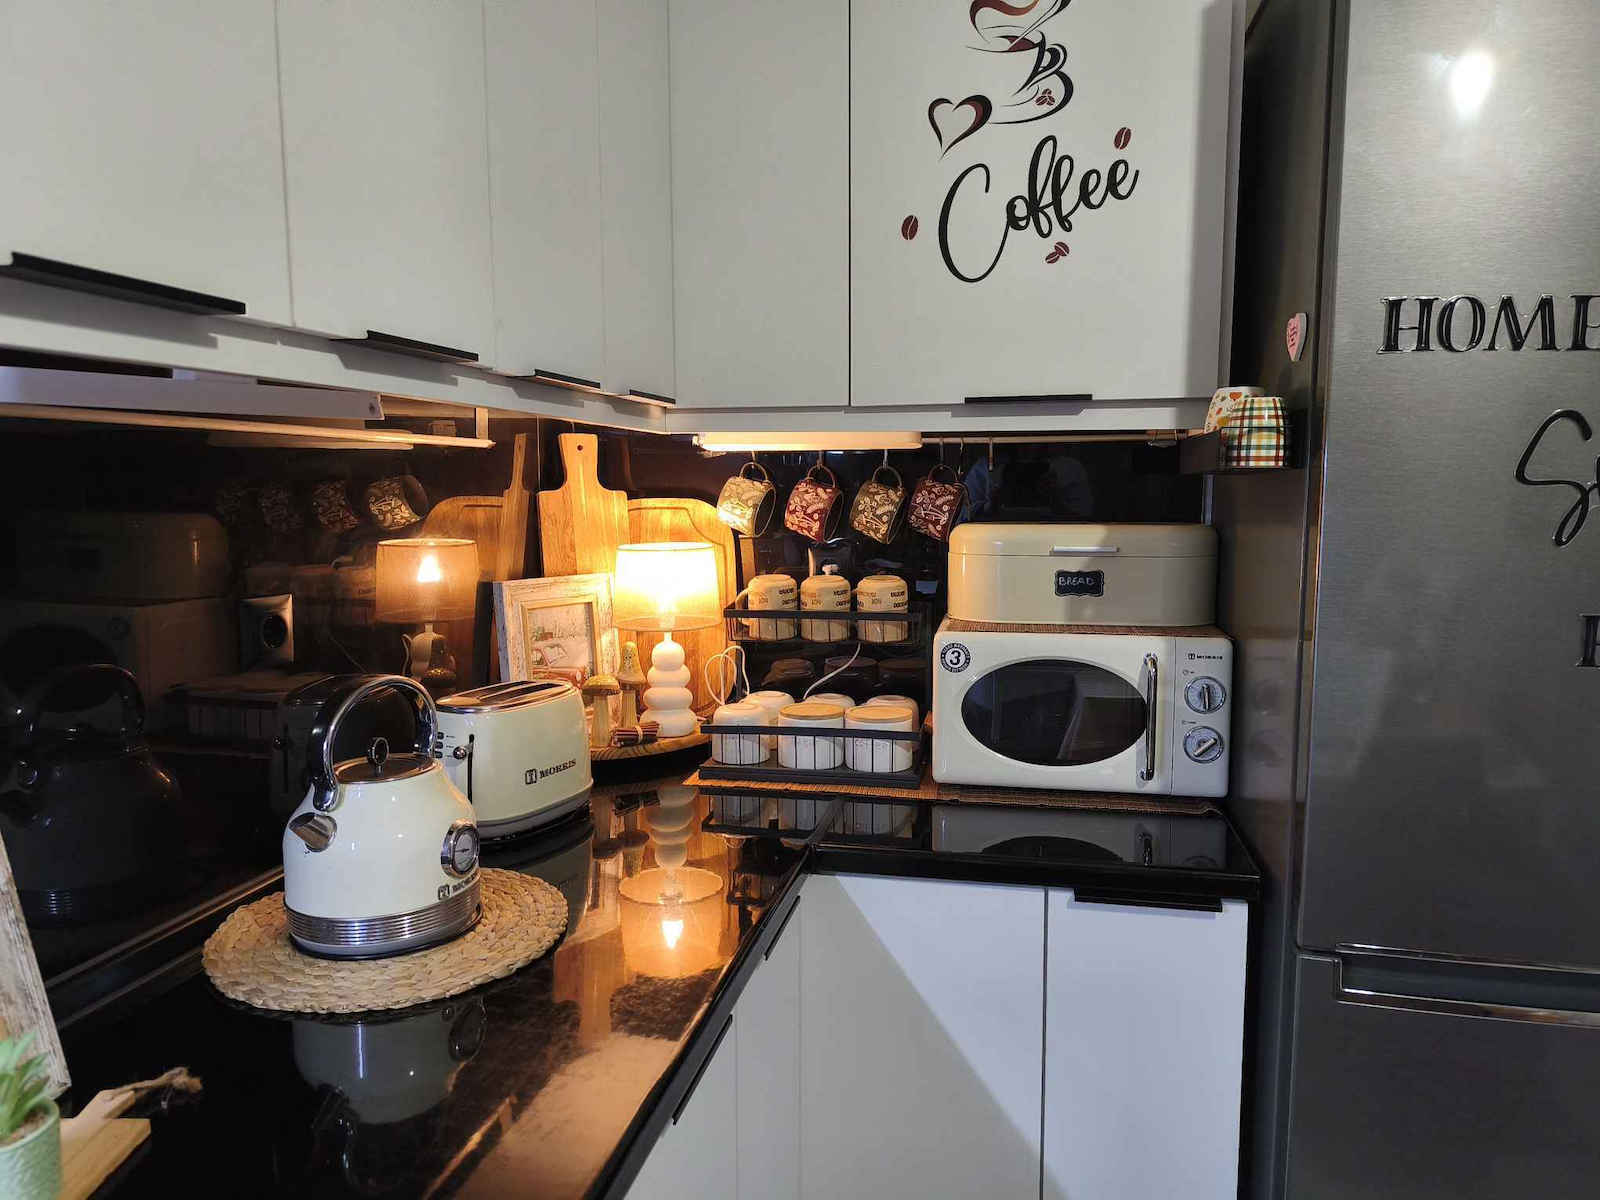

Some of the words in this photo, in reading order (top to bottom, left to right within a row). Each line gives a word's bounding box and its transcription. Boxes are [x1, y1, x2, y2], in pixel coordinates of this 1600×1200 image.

[938, 135, 1139, 283] Coffee
[1513, 408, 1600, 547] S
[1058, 576, 1095, 586] BREAD
[949, 650, 961, 666] 3
[539, 758, 577, 779] MORRIS
